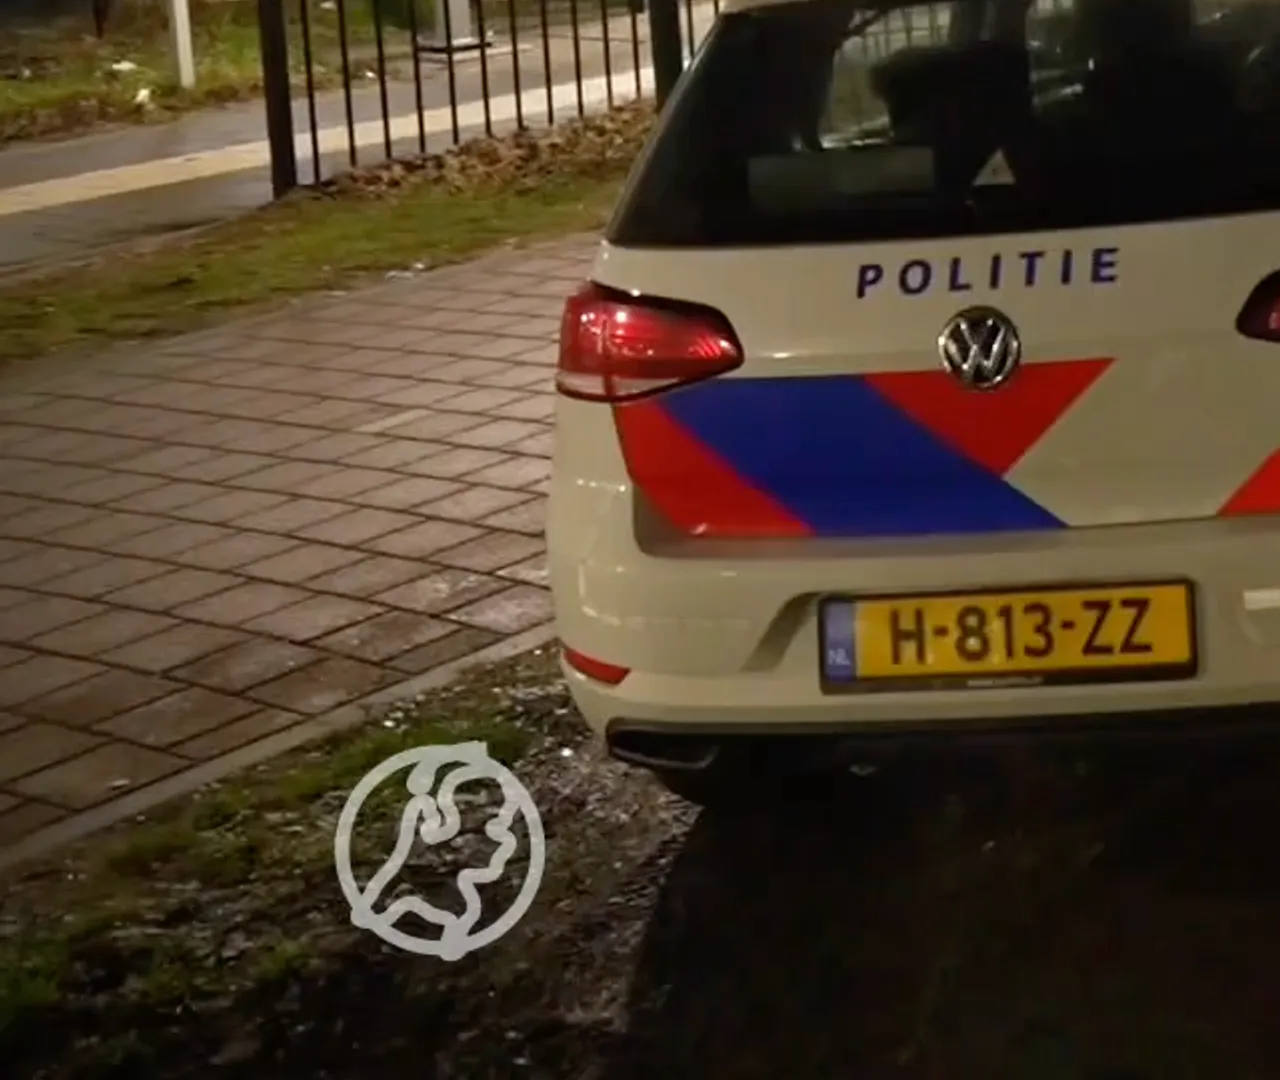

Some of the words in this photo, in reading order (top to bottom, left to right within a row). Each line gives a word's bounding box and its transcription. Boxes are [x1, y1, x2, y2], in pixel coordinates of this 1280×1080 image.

[856, 247, 1120, 299] POLITIE
[828, 648, 850, 666] NL
[888, 597, 1154, 666] H-813-ZZ
